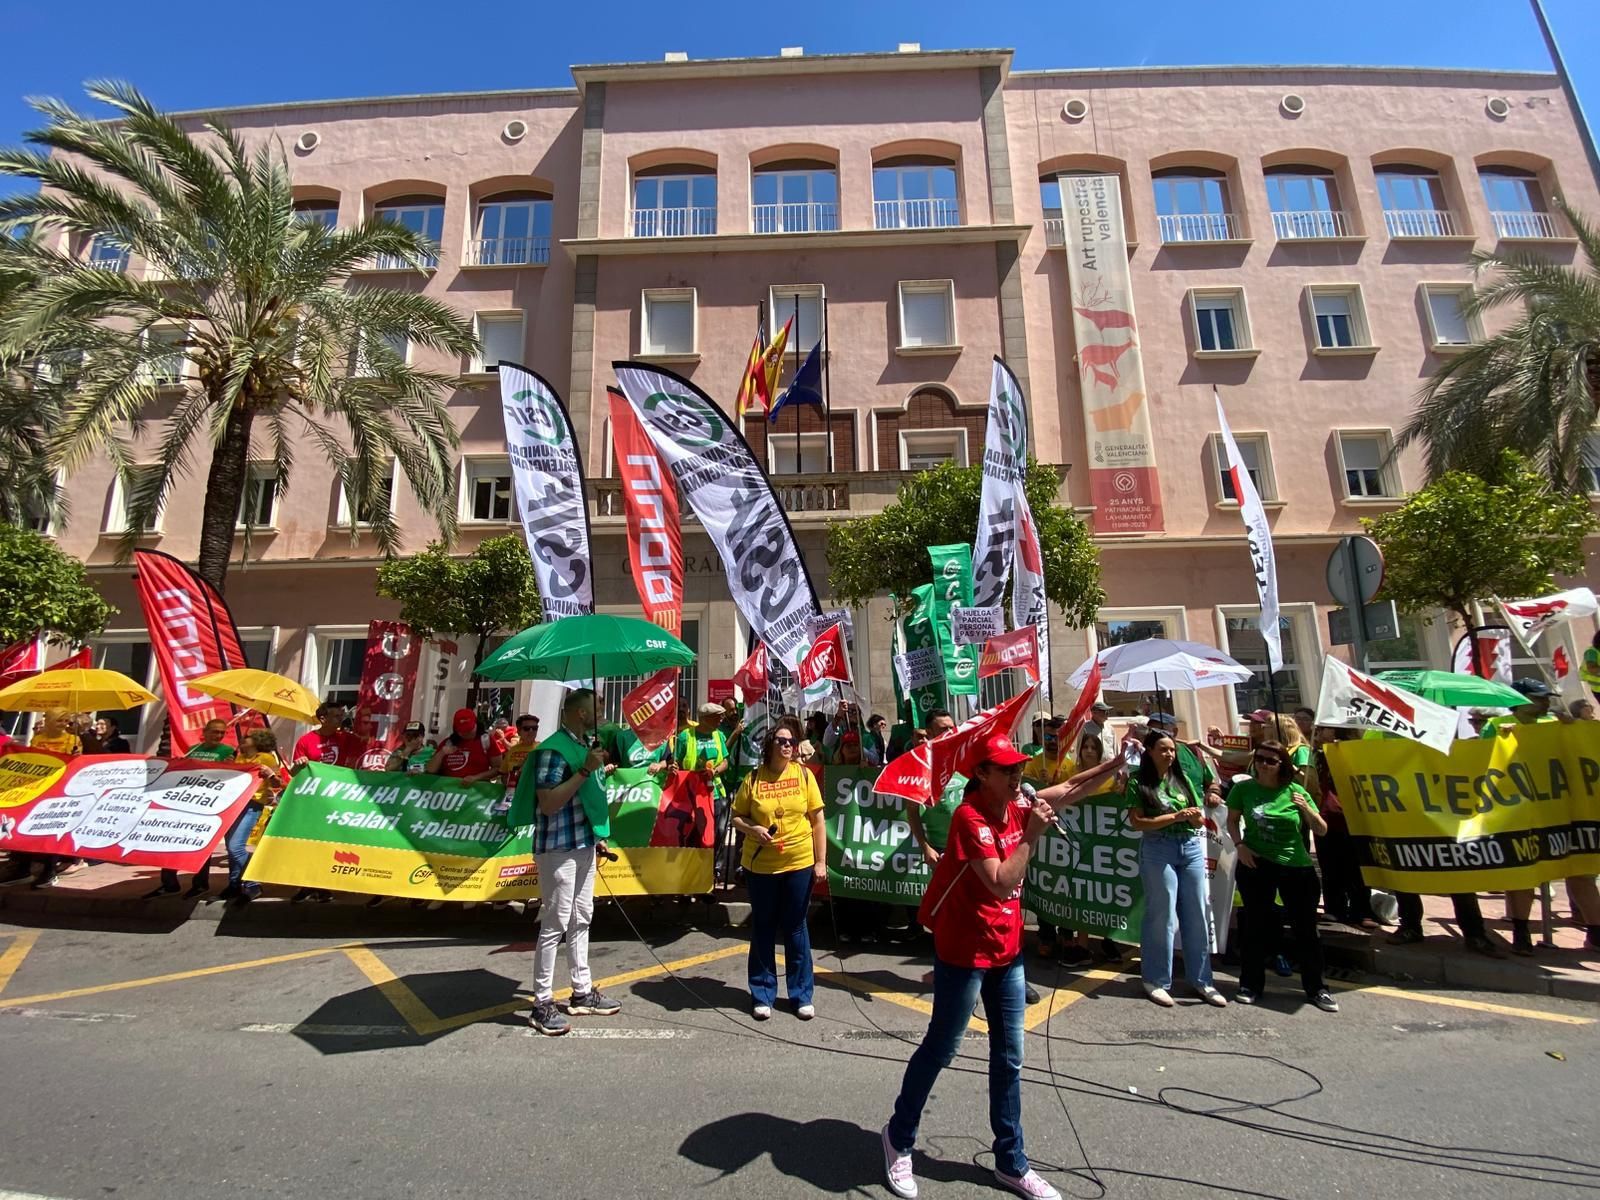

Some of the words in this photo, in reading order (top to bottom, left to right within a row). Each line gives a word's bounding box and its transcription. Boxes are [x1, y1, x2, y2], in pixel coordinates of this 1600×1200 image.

[1076, 178, 1095, 243] rupestre
[1082, 247, 1097, 271] Art
[646, 640, 667, 649] CSIF
[370, 632, 411, 741] UGT
[1350, 697, 1427, 740] STEPV
[362, 754, 390, 768] UGT
[176, 774, 225, 791] pujada
[1349, 773, 1407, 813] PER
[1413, 757, 1572, 816] L'ESCOLA
[162, 790, 218, 807] salarial
[294, 776, 319, 796] JA
[321, 779, 368, 801] N'HI
[372, 786, 401, 805] HA
[401, 789, 468, 813] PROU!
[607, 784, 653, 805] àtios
[835, 777, 904, 811] SOM
[97, 803, 137, 814] alumnat
[95, 815, 119, 825] molt
[325, 810, 404, 832] +salari
[836, 814, 845, 840] I
[75, 826, 122, 839] elevades
[128, 833, 142, 841] de
[1035, 835, 1140, 878] IBLES
[1395, 834, 1505, 868] INVERSIÓ
[1511, 830, 1540, 863] MÉS
[841, 847, 886, 872] ALS
[330, 864, 362, 877] STEPV
[414, 869, 434, 879] CSIF
[440, 865, 463, 874] Central
[501, 866, 527, 877] CCOO
[495, 876, 538, 888] educació
[843, 876, 893, 894] PERSONAL
[1082, 908, 1129, 930] SERVEIS
